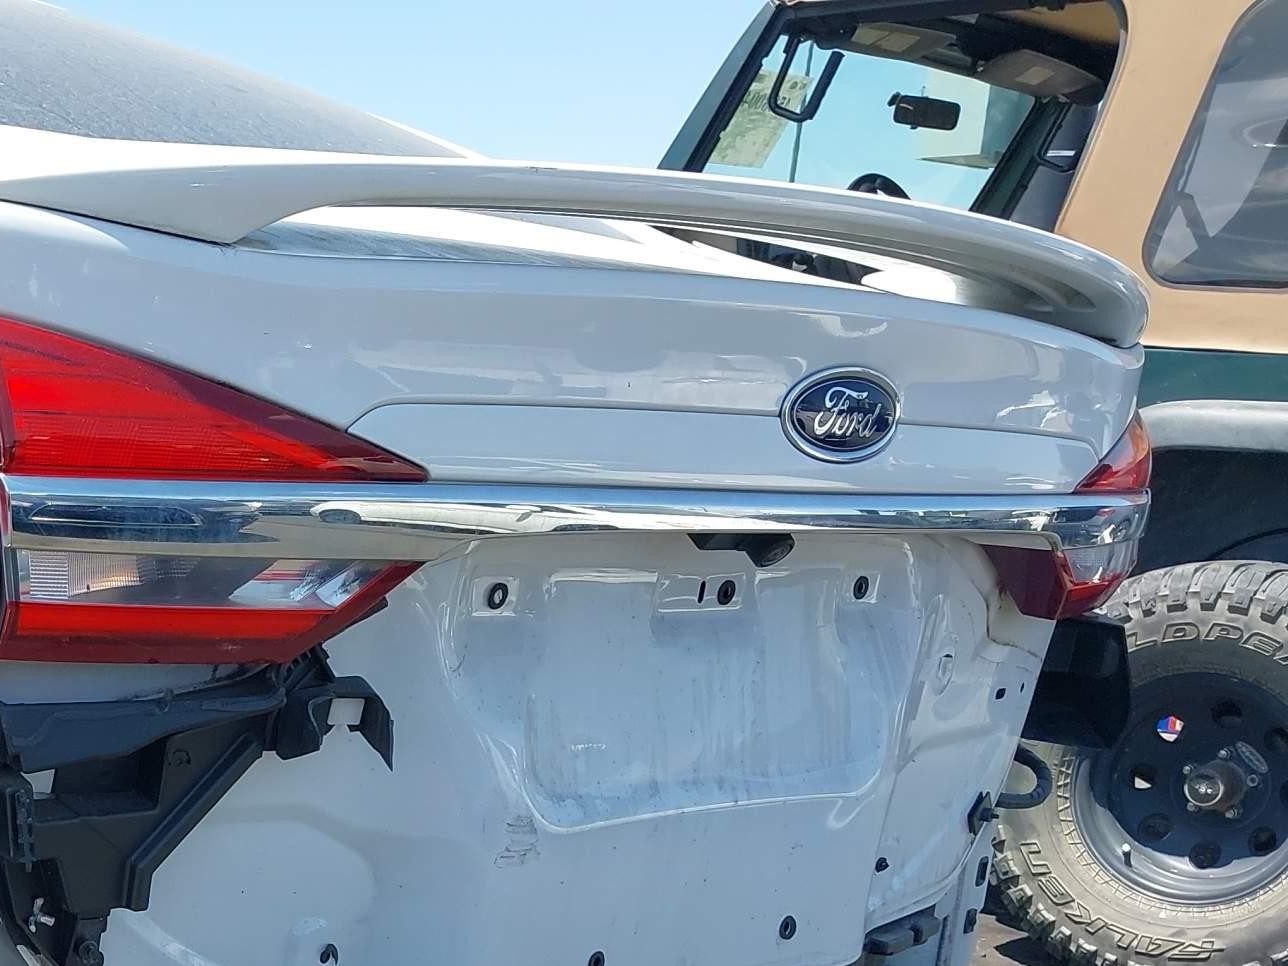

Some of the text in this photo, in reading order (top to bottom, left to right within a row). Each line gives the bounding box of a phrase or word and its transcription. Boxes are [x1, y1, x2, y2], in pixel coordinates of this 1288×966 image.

[814, 386, 881, 439] Ford
[1128, 621, 1288, 665] LDPE
[1020, 841, 1224, 960] FALKEN
